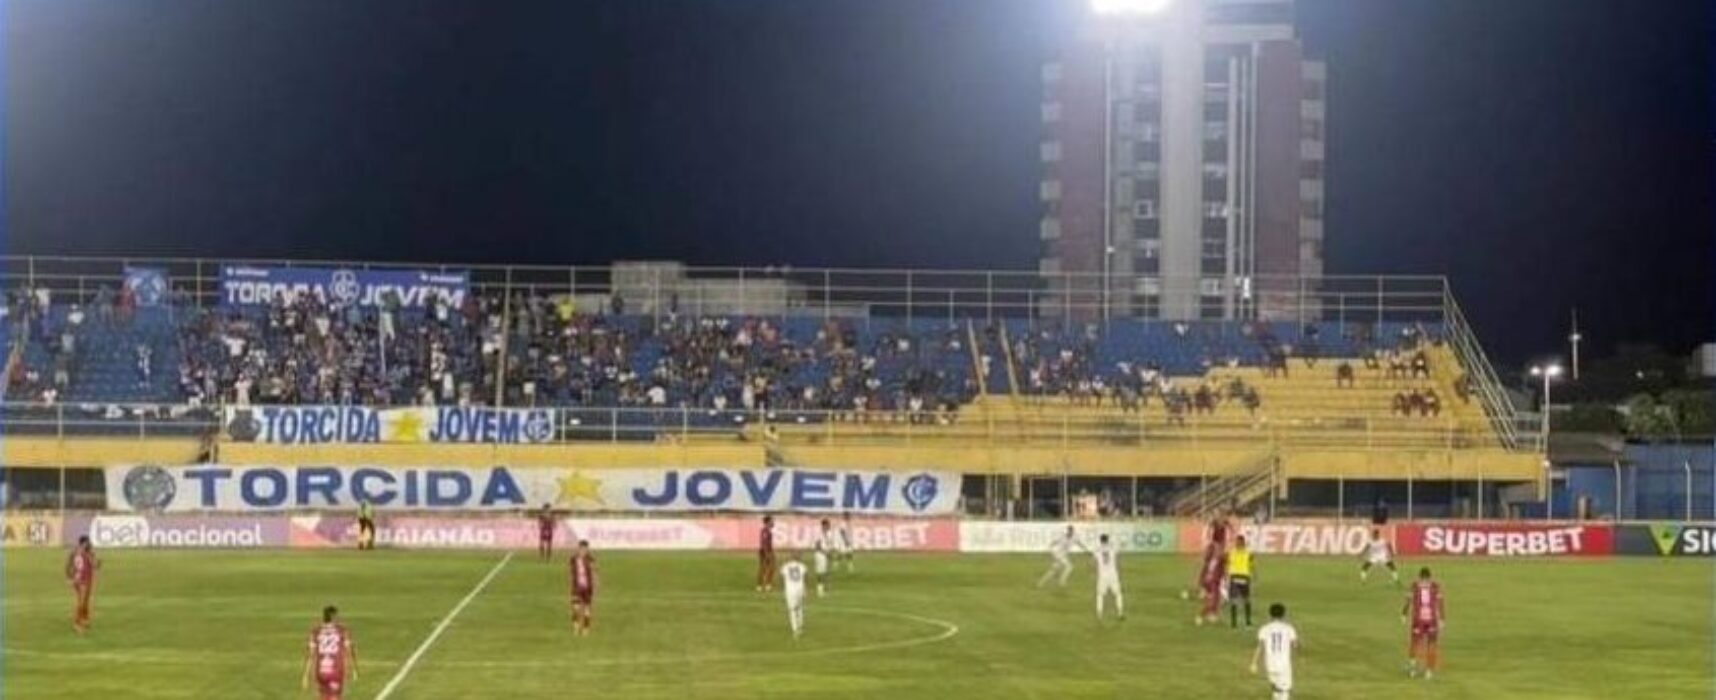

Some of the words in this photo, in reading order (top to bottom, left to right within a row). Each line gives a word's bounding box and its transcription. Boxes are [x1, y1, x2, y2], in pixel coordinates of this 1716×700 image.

[263, 408, 380, 443] TORCIDA
[429, 408, 519, 443] JOVEM
[184, 468, 526, 507] TORCIDA
[632, 470, 891, 508] JOVEM
[772, 520, 931, 549] SURBET
[1241, 524, 1369, 554] BETANO
[1424, 527, 1585, 556] SUPERBET
[1683, 528, 1716, 553] SI
[1271, 631, 1282, 653] 11
